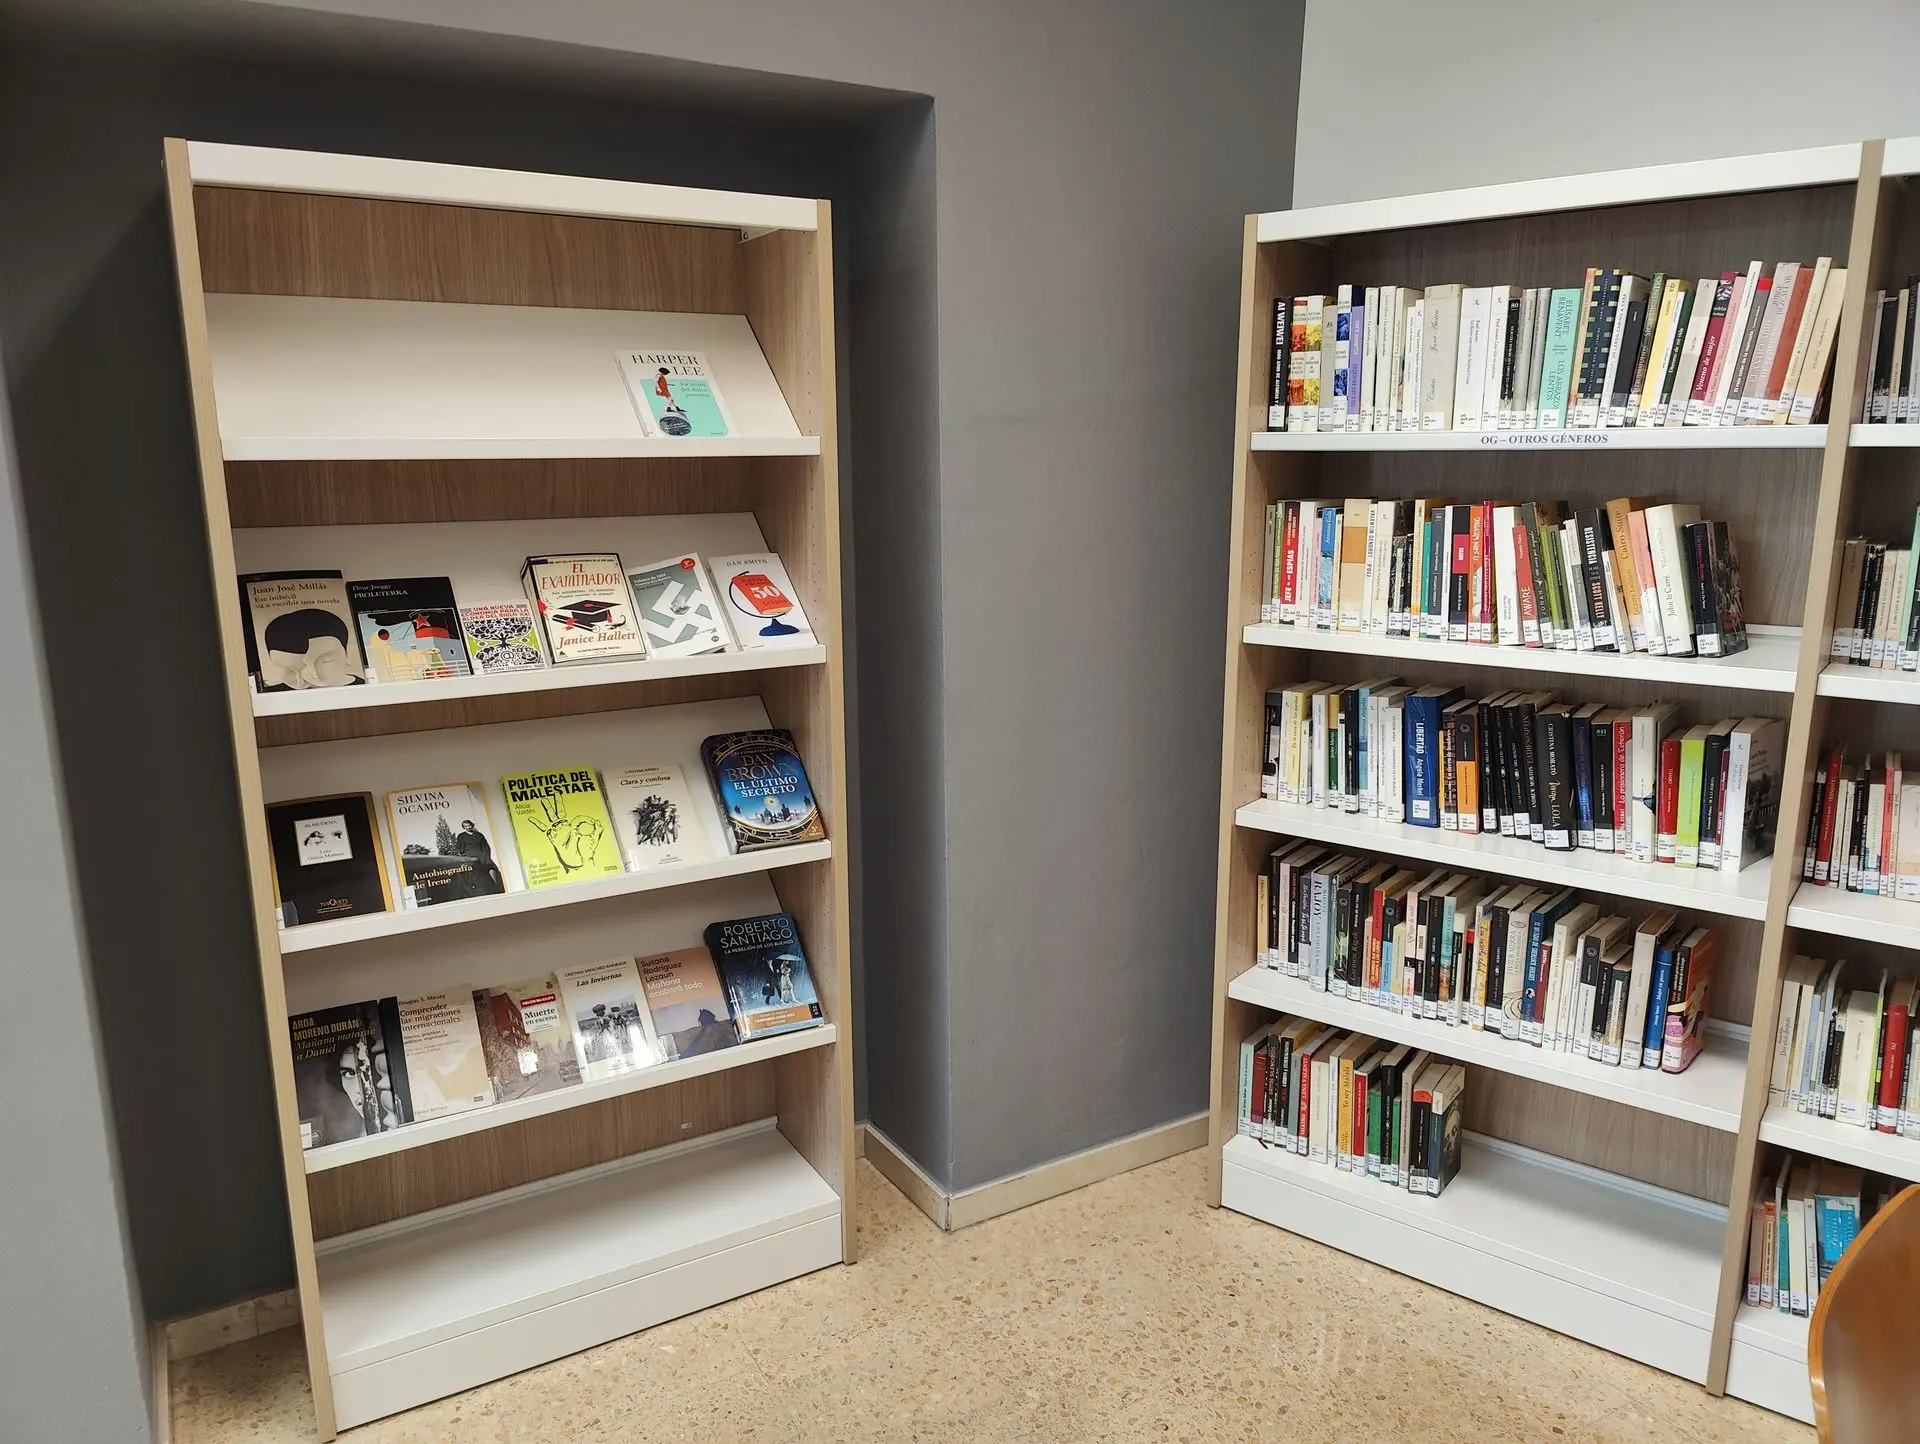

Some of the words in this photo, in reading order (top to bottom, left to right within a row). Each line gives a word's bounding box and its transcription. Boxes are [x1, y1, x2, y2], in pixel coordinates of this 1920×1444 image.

[1278, 302, 1286, 311] AI
[1554, 297, 1566, 338] BENAVENT
[1562, 300, 1573, 335] ELÍSABET
[1275, 311, 1286, 345] WEIWEI
[1707, 335, 1716, 354] mujer
[631, 354, 699, 365] HARPER
[1704, 355, 1711, 365] de
[673, 366, 704, 376] LEE
[1696, 363, 1708, 391] Veneno
[1546, 371, 1556, 400] LENTOS
[1481, 435, 1498, 445] OG
[1509, 434, 1549, 444] OTROS
[1551, 432, 1609, 444] GÉNEROS
[1584, 527, 1597, 564] RESISTENCIA
[1619, 540, 1628, 560] Cairo
[573, 564, 586, 573] EL
[252, 585, 275, 595] Juan
[278, 584, 296, 594] José
[298, 582, 327, 590] Millás
[542, 573, 621, 589] EXAMINADOR
[1663, 575, 1672, 593] Carré
[354, 589, 408, 598] PROLETERKA
[750, 585, 781, 599] 50
[1592, 582, 1601, 598] SCOTT
[1522, 586, 1531, 616] AWARE
[1537, 590, 1546, 616] JOHAN
[1594, 598, 1604, 619] KELLY
[1667, 600, 1677, 617] John
[559, 635, 595, 649] Janice
[597, 629, 637, 641] Hallett
[1415, 722, 1425, 754] LIBERTAD
[1547, 723, 1555, 752] CRISTINA
[1416, 757, 1425, 777] Angela
[1549, 752, 1557, 776] MORATÓ
[1619, 756, 1625, 766] de
[509, 774, 570, 791] POLÍTICA
[571, 771, 591, 782] DEL
[645, 775, 671, 783] confusa
[733, 782, 749, 790] EL
[752, 775, 798, 789] ÚLTIMO
[397, 791, 445, 805] SILVINA
[510, 782, 596, 802] MALESTAR
[741, 784, 796, 798] SECRETO
[1619, 790, 1625, 804] La
[399, 800, 450, 815] OCAMPO
[1551, 804, 1561, 827] LOLA
[412, 864, 473, 881] Autobiografía
[427, 877, 452, 889] Irene
[1312, 880, 1323, 918] RAJOY
[723, 917, 789, 937] ROBERTO
[720, 928, 793, 949] SANTIAGO
[640, 956, 670, 967] Susana
[643, 961, 683, 975] Rodríguez
[576, 979, 589, 987] Las
[645, 971, 673, 983] Lezaun
[647, 977, 681, 990] Mañana
[400, 1003, 448, 1017] Comprender
[401, 1017, 413, 1025] las
[414, 1008, 461, 1024] migraciones
[524, 1007, 555, 1020] Muerte
[292, 1018, 315, 1030] AROA
[402, 1017, 461, 1032] internacionales
[535, 1015, 558, 1024] escena
[293, 1025, 330, 1041] MORENO
[305, 1044, 337, 1059] Daniel
[1343, 1097, 1349, 1108] Yo
